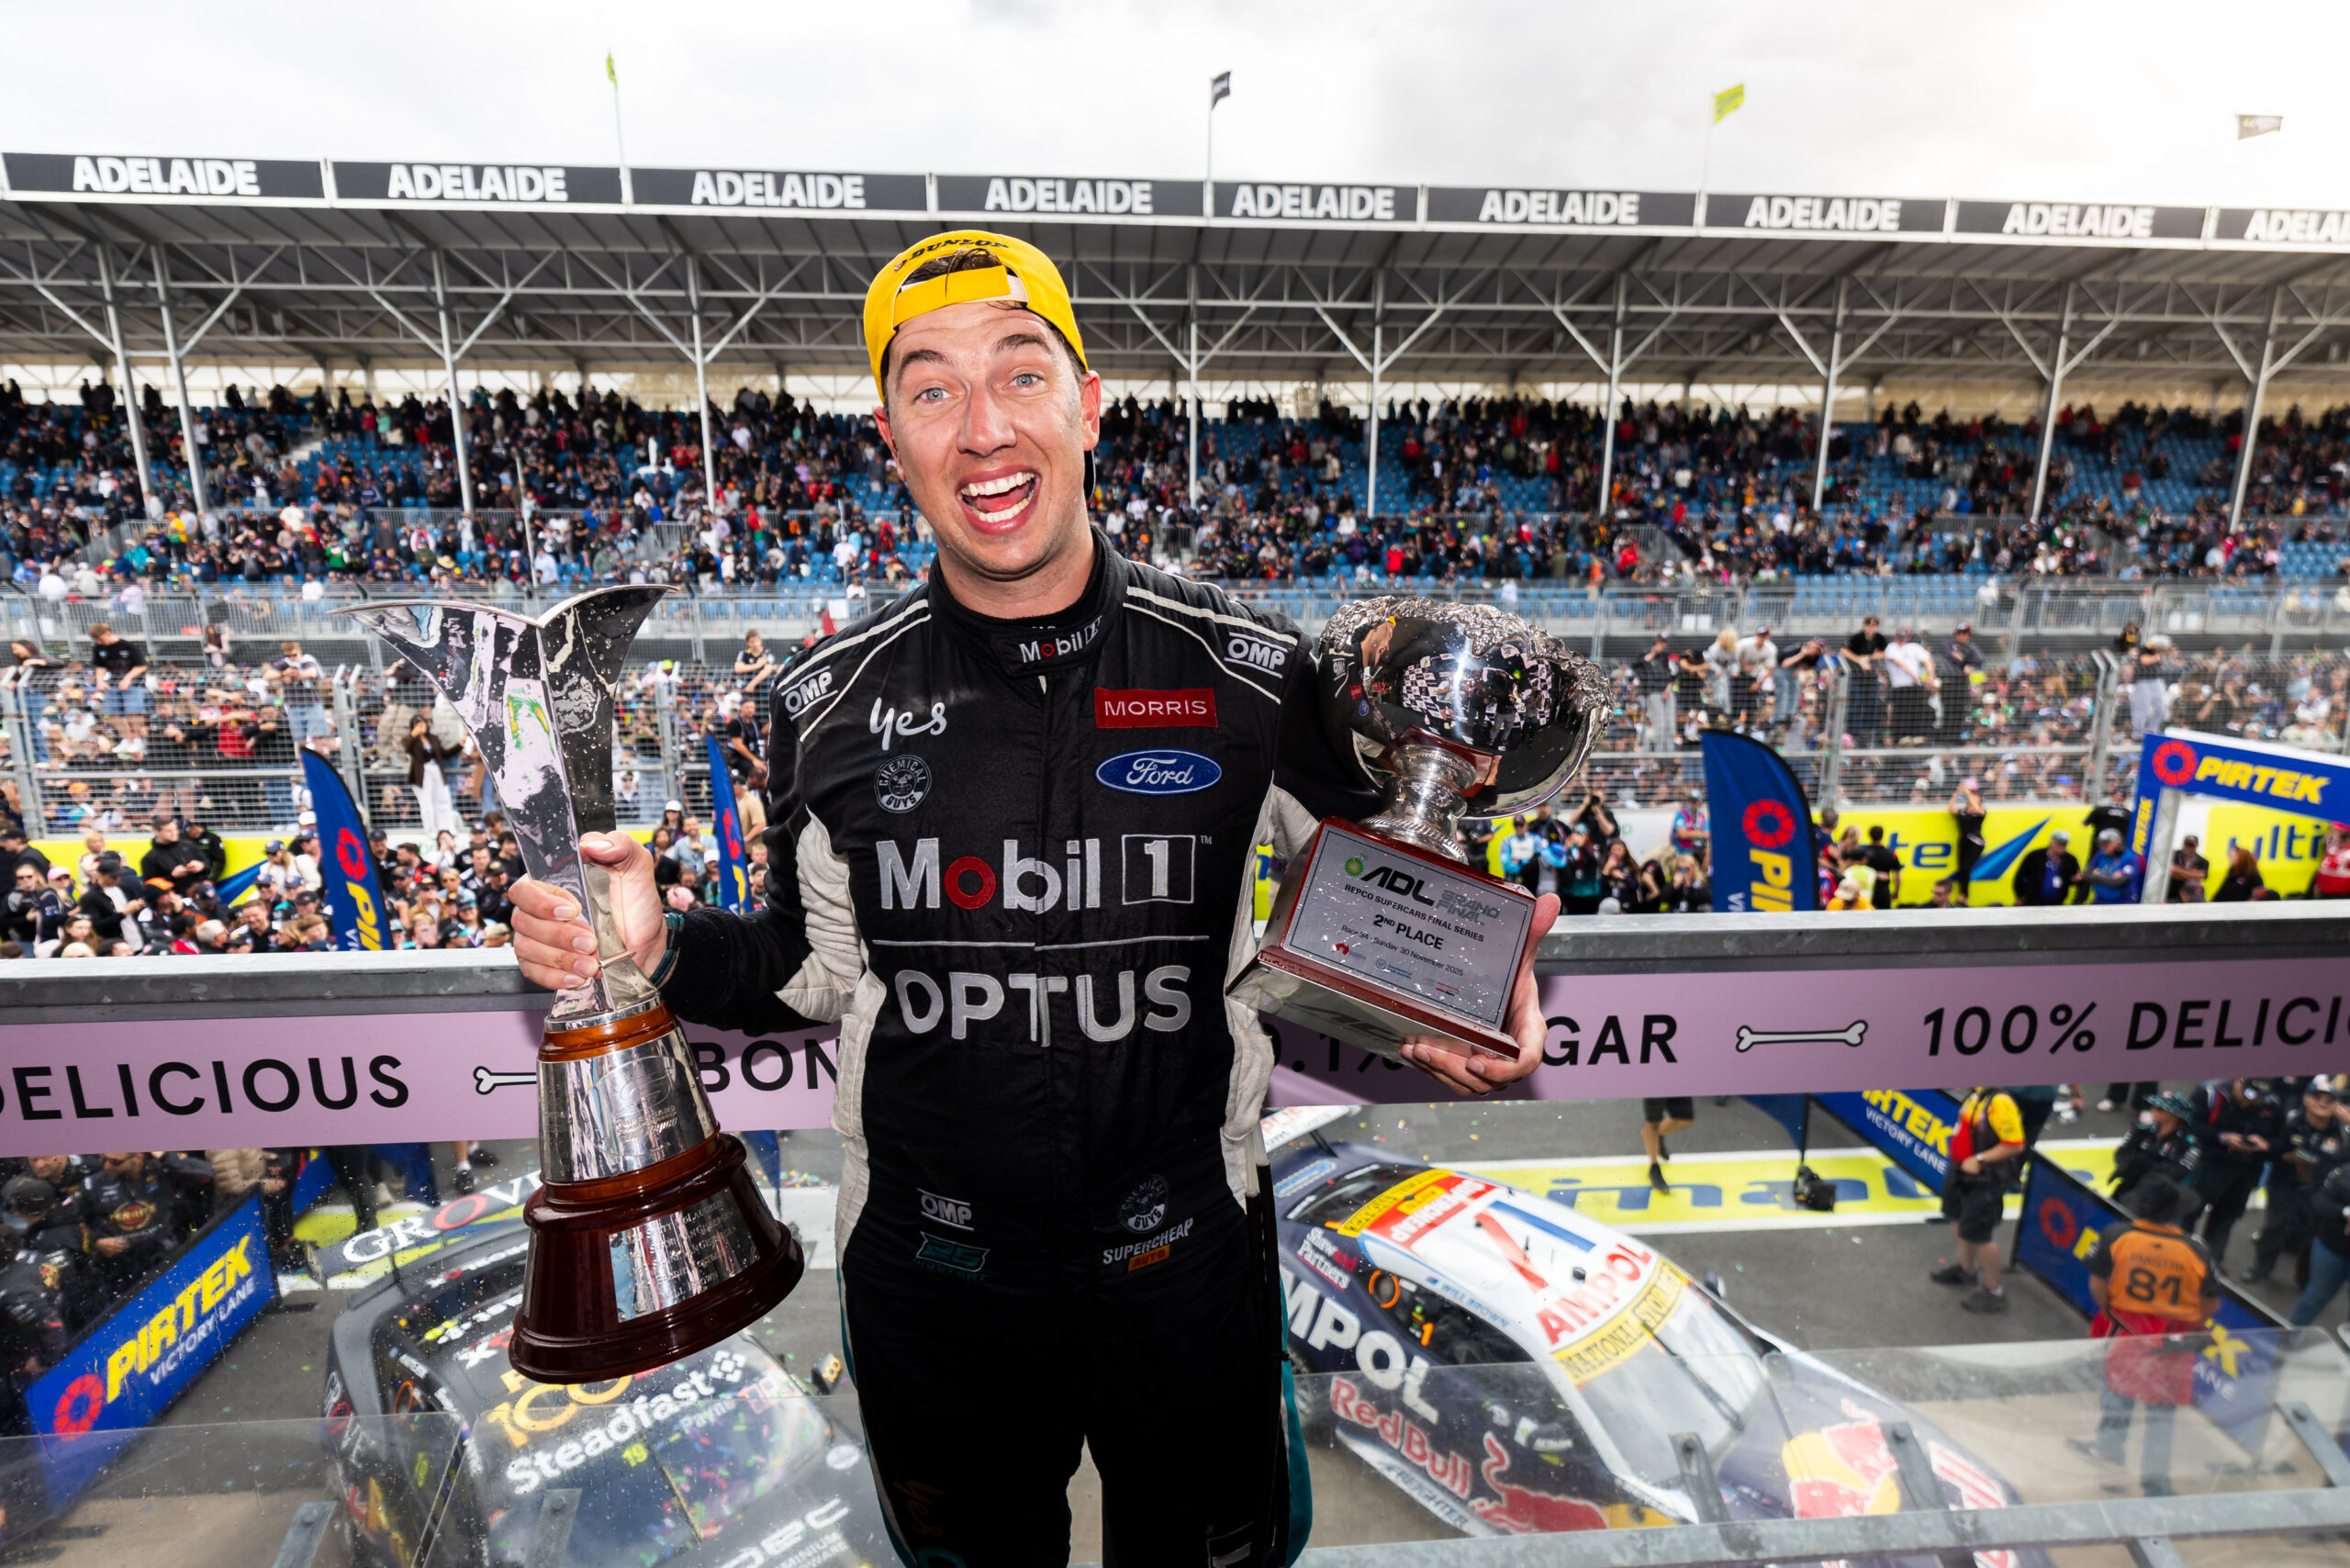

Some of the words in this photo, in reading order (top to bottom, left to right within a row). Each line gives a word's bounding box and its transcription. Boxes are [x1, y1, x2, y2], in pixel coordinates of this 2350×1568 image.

[73, 156, 260, 196] ADELAIDE
[387, 163, 568, 202] ADELAIDE
[690, 171, 866, 208] ADELAIDE
[984, 177, 1153, 214] ADELAIDE
[1232, 184, 1395, 219] ADELAIDE
[1481, 189, 1639, 225] ADELAIDE
[1745, 196, 1901, 231] ADELAIDE
[2003, 204, 2154, 238] ADELAIDE
[909, 238, 1010, 261] DUNLOP
[1019, 631, 1083, 663] Mobil
[1227, 639, 1286, 671] OMP
[785, 672, 834, 714] OMP
[1104, 700, 1208, 717] MORRIS
[869, 697, 947, 750] yes
[878, 759, 927, 787] CHEMICAL
[1125, 756, 1195, 786] Ford
[2195, 756, 2332, 805] PIRTEK
[885, 793, 917, 809] GUYS
[875, 836, 1102, 915] Mobil
[1360, 866, 1436, 907] ADL
[1345, 883, 1374, 901] REPCO
[1374, 895, 1427, 921] SUPERCARS
[1427, 915, 1452, 932] FINAL
[1453, 925, 1485, 943] SERIES
[1436, 899, 1485, 926] FINAL
[1440, 889, 1500, 919] GRAND
[1341, 924, 1359, 935] Race
[1360, 930, 1370, 940] 34
[1373, 936, 1398, 952] Sunday
[1400, 946, 1410, 956] 30
[1410, 950, 1446, 969] November
[1445, 964, 1465, 977] 2025
[1372, 914, 1395, 928] 2ND
[1395, 922, 1444, 951] PLACE
[894, 965, 1192, 1047] OPTUS
[1923, 1002, 2098, 1058] 100%
[2126, 996, 2350, 1052] DELICI
[0, 1055, 409, 1120] ELICIOUS
[1865, 1106, 1915, 1148] VICTORY
[1913, 1142, 1948, 1176] LANE
[920, 1193, 973, 1226] OMP
[1121, 1178, 1166, 1210] CHEMICAL
[1134, 1204, 1163, 1229] GUYS
[1102, 1217, 1194, 1265] SUPERCHEAP
[1131, 1249, 1167, 1269] AUTO
[1296, 1238, 1351, 1290] Partners
[1442, 1282, 1466, 1304] WILL
[1468, 1295, 1511, 1329] BROWN
[1536, 1243, 1652, 1346] AMPOL
[2125, 1266, 2182, 1306] 81
[106, 1233, 252, 1405] PIRTEK
[150, 1316, 219, 1386] VICTORY
[218, 1278, 256, 1323] LANE
[1421, 1321, 1435, 1347] 1
[1562, 1319, 1645, 1379] NATIONAL
[504, 1370, 716, 1495] Steadfast
[1330, 1375, 1403, 1450] Red
[1401, 1419, 1472, 1501] Bull
[621, 1442, 648, 1468] 19
